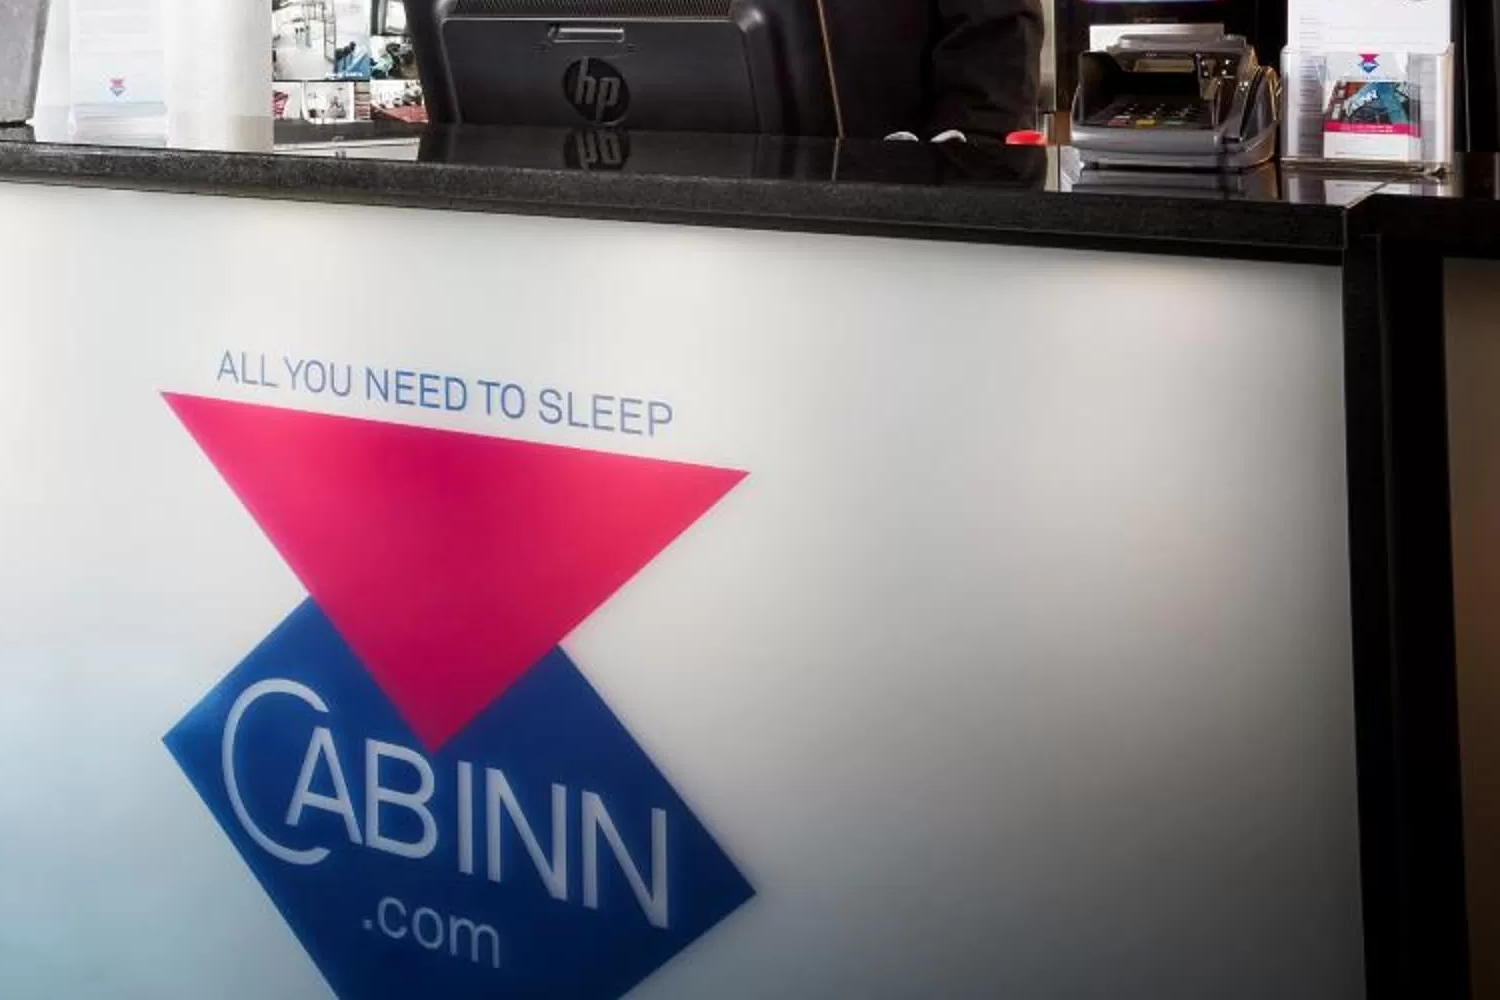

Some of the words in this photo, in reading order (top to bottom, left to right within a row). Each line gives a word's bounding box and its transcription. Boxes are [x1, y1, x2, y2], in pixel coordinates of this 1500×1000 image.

[575, 56, 621, 123] hp
[216, 349, 278, 388] ALL
[284, 356, 352, 397] YOU
[365, 366, 468, 412] NEED
[477, 380, 526, 420] TO
[538, 388, 674, 438] SLEEP
[221, 678, 670, 929] CABINN
[362, 896, 501, 969] .com
